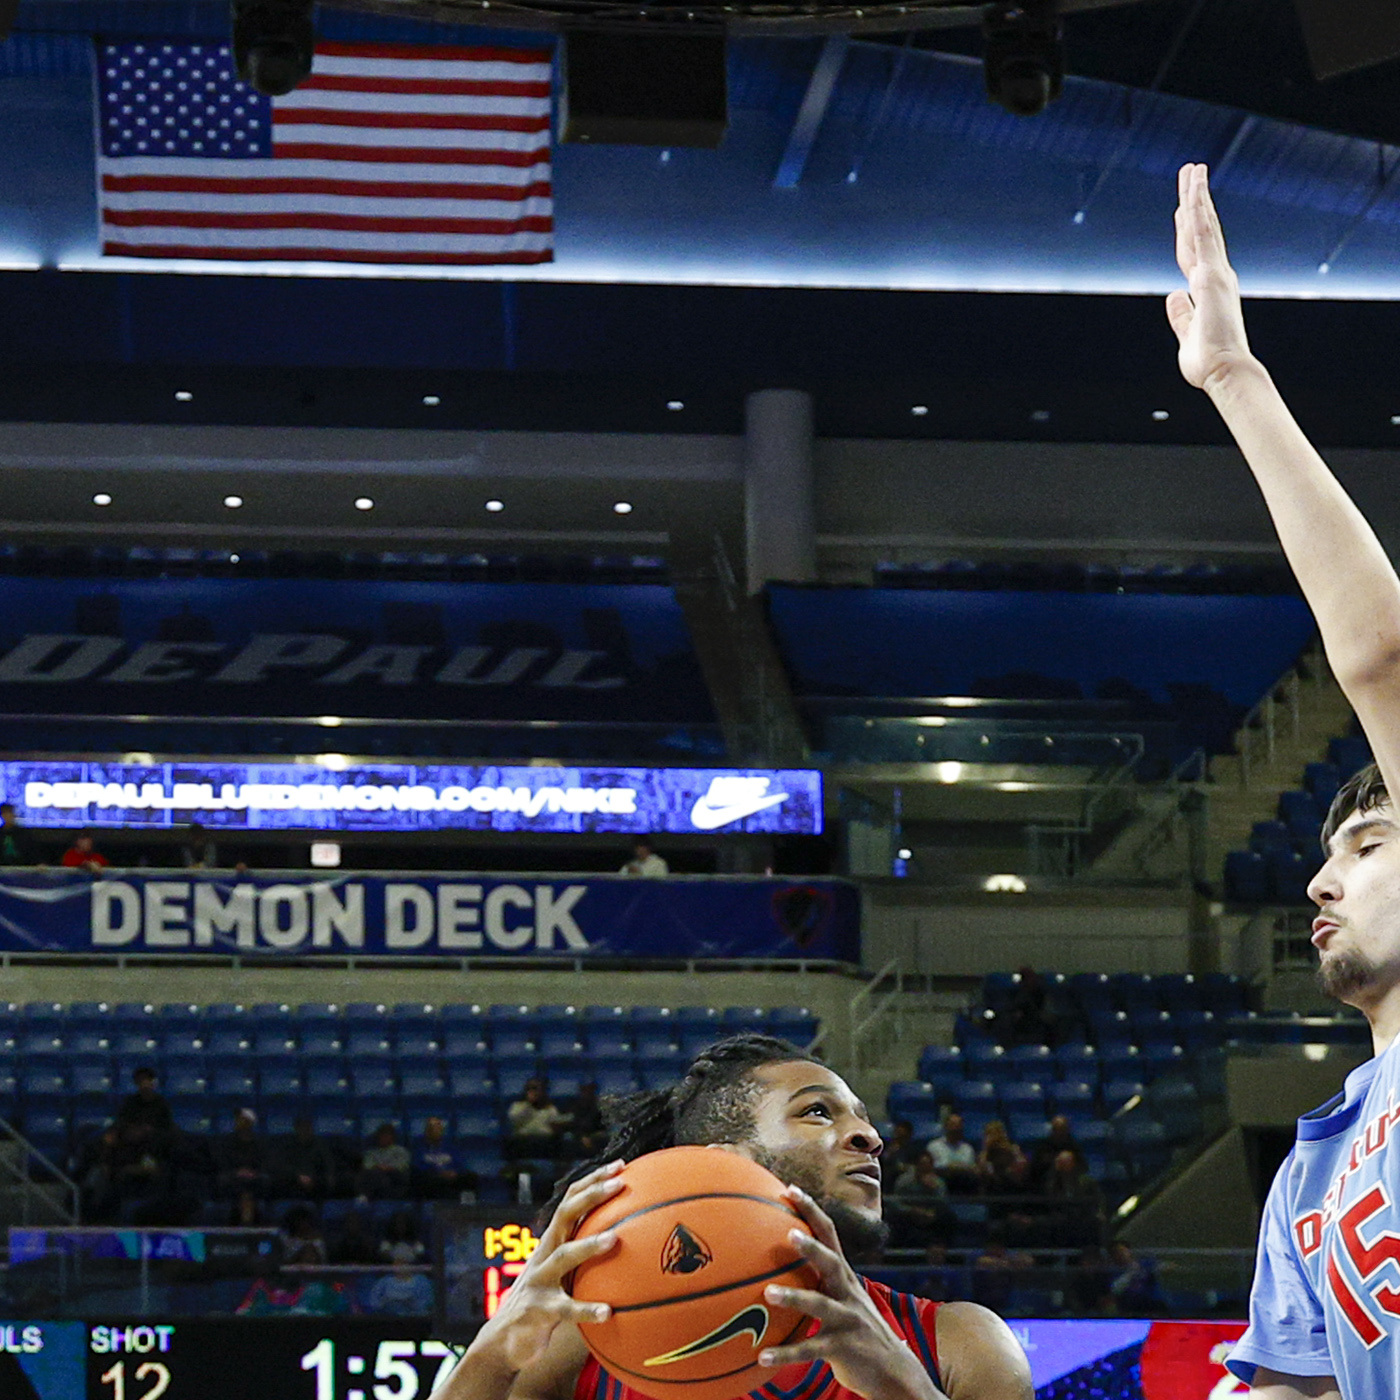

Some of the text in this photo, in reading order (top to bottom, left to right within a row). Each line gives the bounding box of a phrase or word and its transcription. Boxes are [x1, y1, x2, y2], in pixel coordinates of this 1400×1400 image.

[91, 881, 590, 949] DEMON DECK
[91, 1325, 174, 1353] SHOT
